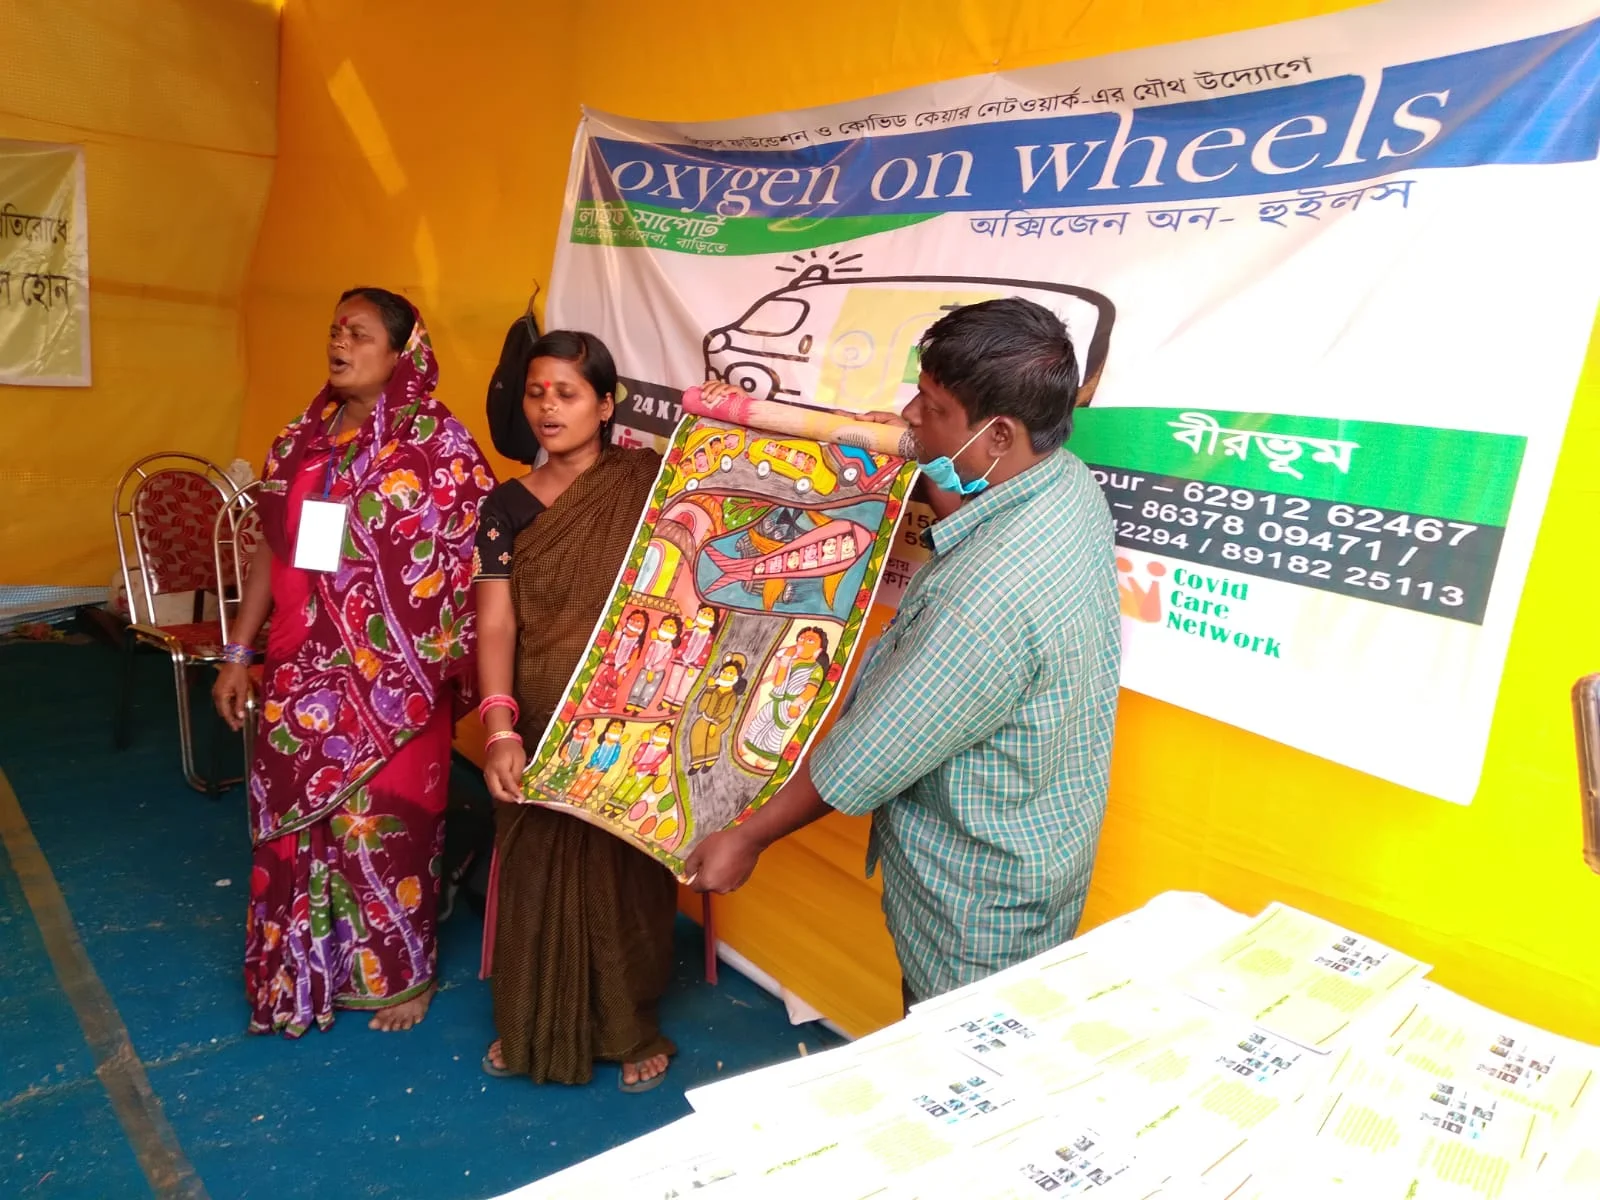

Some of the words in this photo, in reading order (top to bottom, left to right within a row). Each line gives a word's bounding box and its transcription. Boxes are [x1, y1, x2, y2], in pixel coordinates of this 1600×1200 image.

[815, 126, 832, 138] ও
[838, 113, 907, 135] কোভিড
[914, 105, 971, 127] কেয়ার
[1133, 78, 1186, 101] যৌথ
[1193, 56, 1313, 90] উদ্যোগে
[612, 159, 840, 218] oxygen
[869, 148, 973, 202] on
[1013, 70, 1452, 194] wheels
[633, 208, 728, 238] সাপোর্ট
[970, 208, 1131, 240] অক্সিজেন
[22, 271, 71, 312] হোন
[632, 394, 655, 416] 24
[1166, 411, 1361, 480] বীরভূম
[1141, 500, 1244, 536] 86378
[1258, 520, 1382, 561] 09471
[1183, 481, 1311, 521] 62912
[1327, 504, 1479, 547] 62467
[1173, 568, 1249, 601] Covid
[1221, 542, 1333, 579] 89182
[1343, 566, 1465, 607] 25113
[1170, 590, 1230, 619] Care
[1166, 611, 1282, 659] Network
